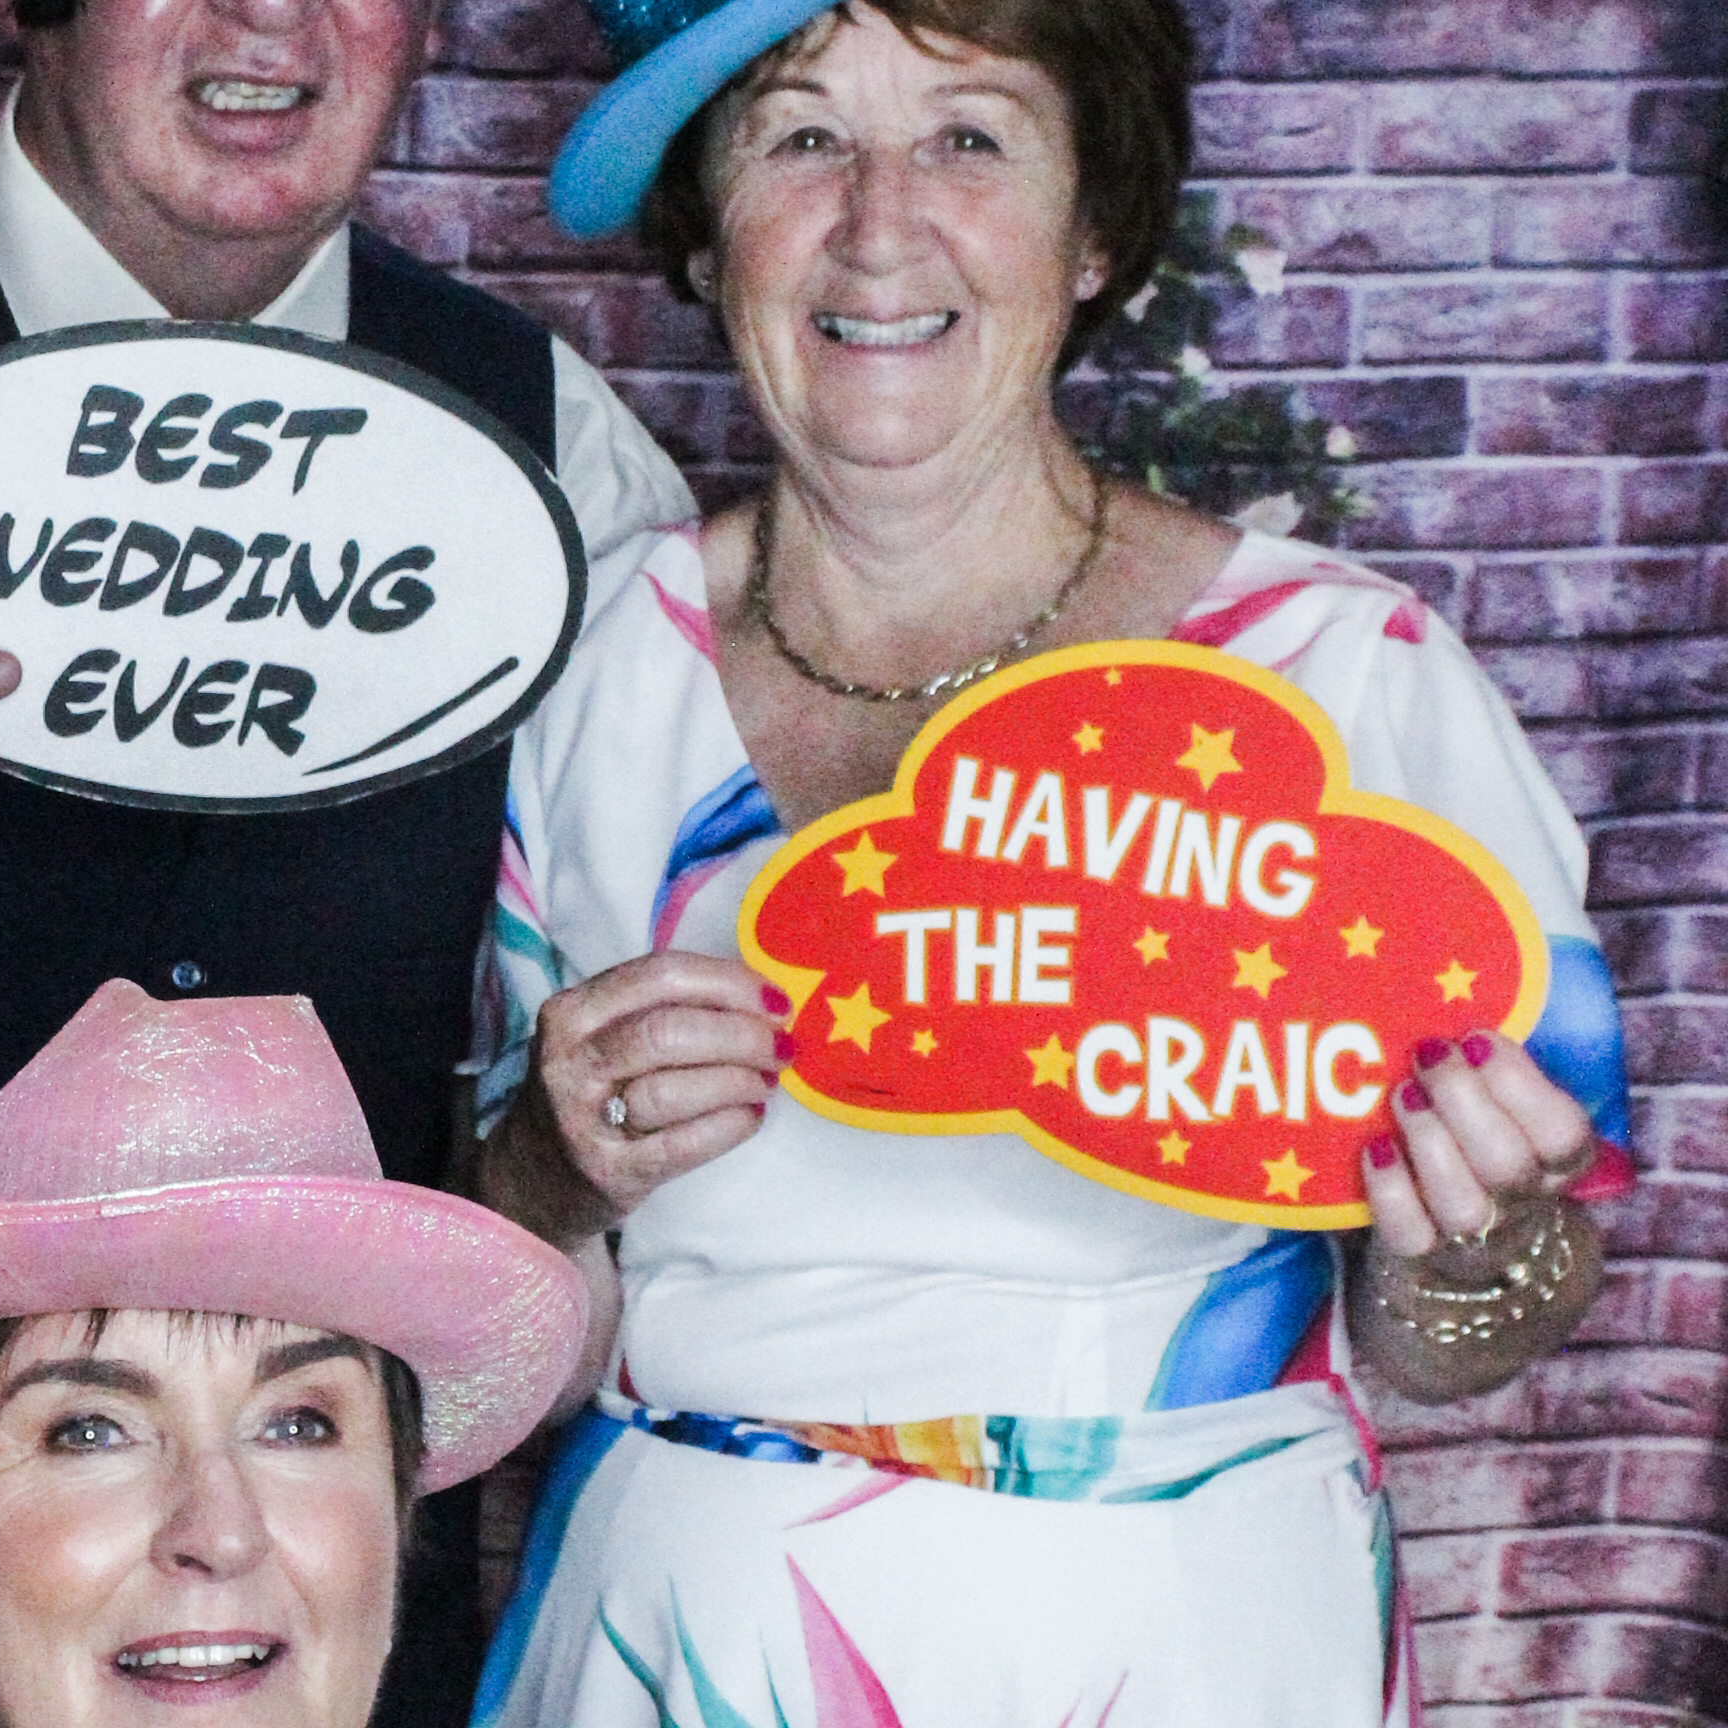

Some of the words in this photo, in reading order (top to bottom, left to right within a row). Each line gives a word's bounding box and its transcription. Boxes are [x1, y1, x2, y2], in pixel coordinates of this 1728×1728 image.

[66, 384, 368, 495] BEST
[43, 648, 317, 757] EVER
[941, 756, 1317, 919] HAVING
[875, 906, 1076, 1005] THE
[1074, 1015, 1383, 1123] CRAIC
